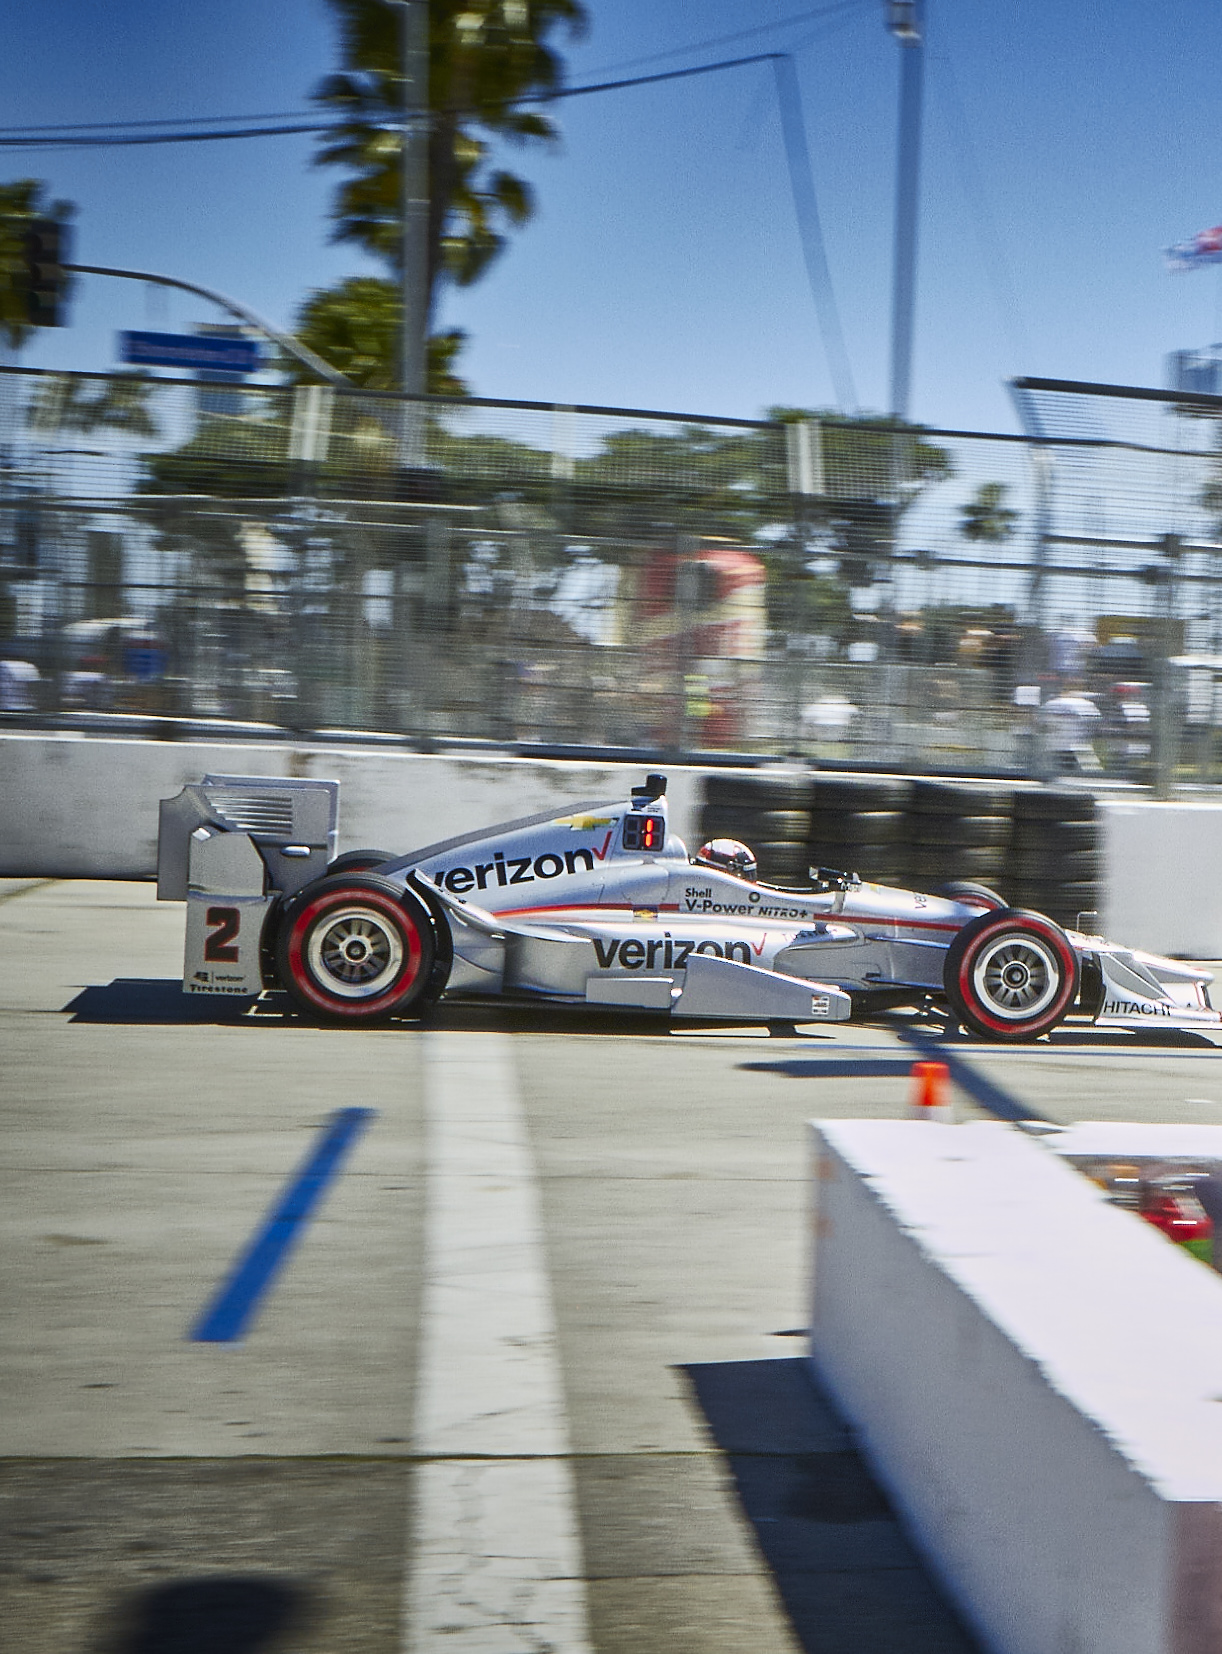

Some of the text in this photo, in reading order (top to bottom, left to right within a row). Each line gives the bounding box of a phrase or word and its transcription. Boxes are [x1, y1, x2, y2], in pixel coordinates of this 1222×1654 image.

[685, 888, 712, 898] Shell
[685, 899, 754, 915] V-Power
[204, 907, 240, 963] 2
[190, 984, 248, 993] Firestone
[1103, 1001, 1171, 1016] HITACHI
